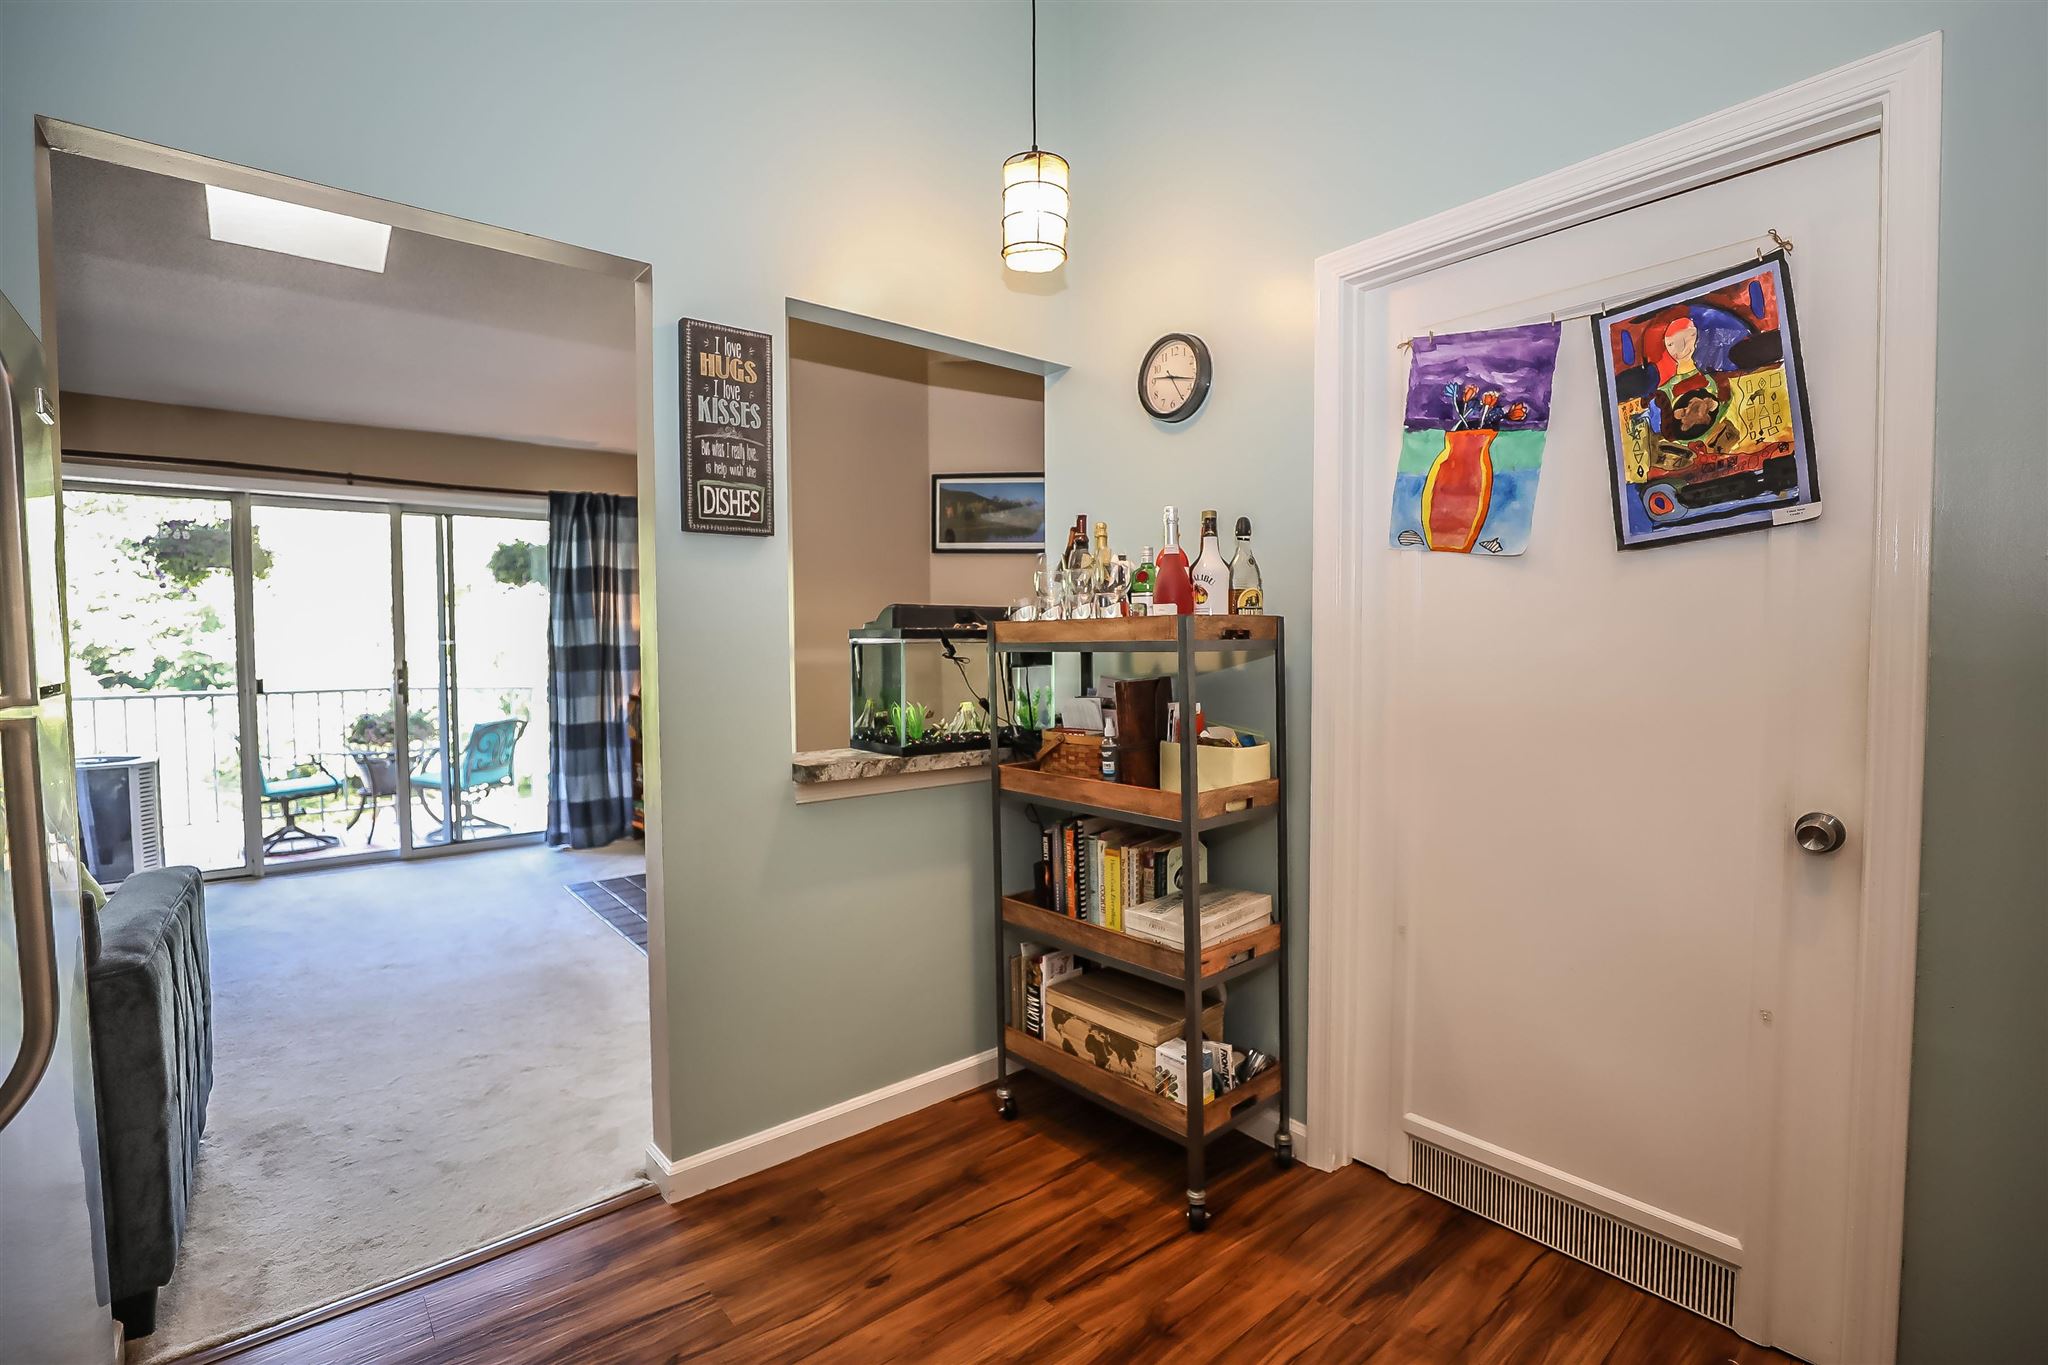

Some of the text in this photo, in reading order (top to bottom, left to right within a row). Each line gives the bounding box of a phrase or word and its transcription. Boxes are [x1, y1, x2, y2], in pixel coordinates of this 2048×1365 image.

[714, 336, 742, 359] I love
[1171, 346, 1179, 357] 12
[1161, 353, 1168, 362] 11
[700, 352, 758, 384] HUGS
[1153, 365, 1161, 374] 10
[713, 379, 741, 401] I love
[1153, 391, 1159, 400] 8
[1161, 398, 1166, 407] 7
[1170, 399, 1176, 408] 6
[698, 395, 762, 429] KISSES
[701, 439, 711, 456] But
[711, 440, 725, 458] what
[726, 442, 730, 458] I
[731, 443, 745, 466] really
[705, 461, 757, 479] is help with the
[702, 485, 760, 517] DISHES
